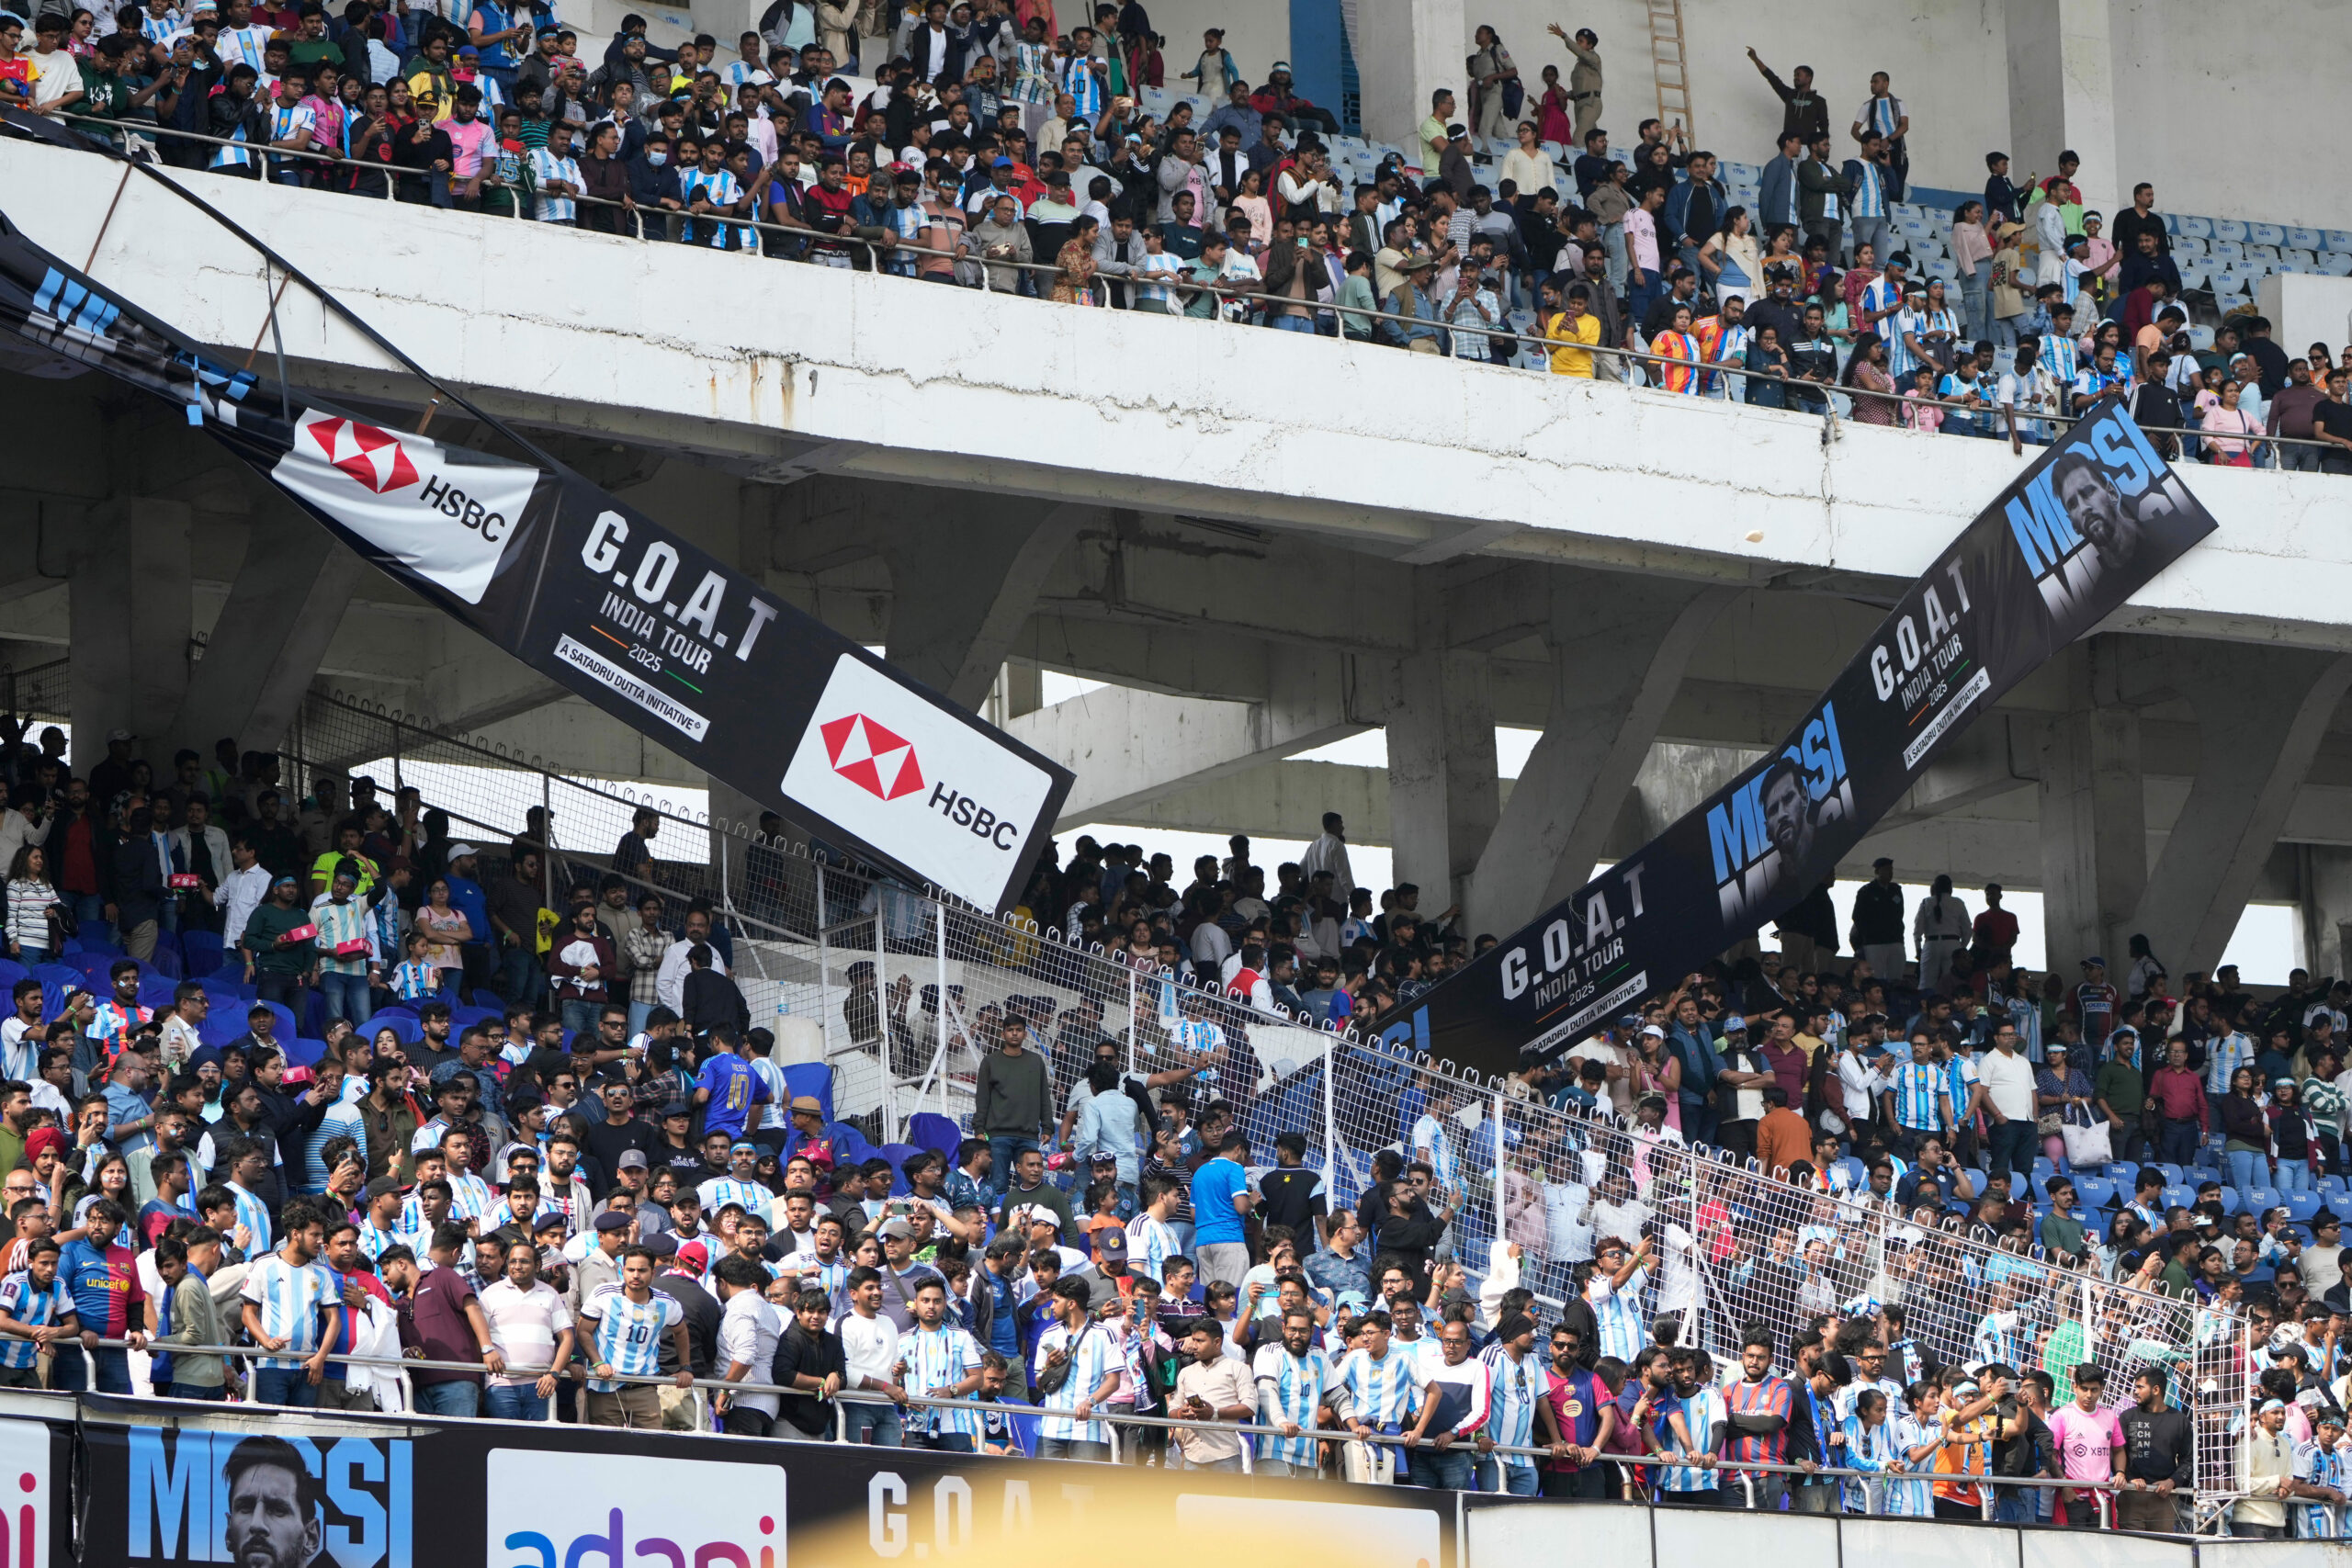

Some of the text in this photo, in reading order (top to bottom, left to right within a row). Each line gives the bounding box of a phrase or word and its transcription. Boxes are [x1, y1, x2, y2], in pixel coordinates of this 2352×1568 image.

[1073, 79, 1086, 94] 10
[420, 474, 506, 544] HSBC
[582, 510, 779, 661] G.O.A.T
[599, 591, 712, 674] INDIA TOUR
[1871, 555, 1970, 702] G.O.A.T
[628, 643, 663, 672] 2025
[1901, 633, 1963, 712] INDIA TOUR
[560, 643, 694, 731] A SATADRU DUTTA INITIATIVE
[1928, 679, 1948, 707] 2025
[1907, 682, 1981, 764] A SATADRU DUTTA INITIATIVE
[928, 781, 1018, 852] HSBC
[1500, 861, 1645, 1000] G.O.A.T
[1534, 937, 1624, 1010] INDIA TOUR
[1568, 982, 1595, 1007] 2025
[1569, 1010, 1596, 1035] DUTTA
[1596, 983, 1637, 1017] INITIATIVE
[727, 1073, 750, 1111] 10
[86, 1277, 119, 1290] unicef
[626, 1324, 649, 1344] 10
[1299, 1383, 1311, 1398] 10
[1516, 1388, 1531, 1404] 10
[2137, 1421, 2150, 1429] EX
[2137, 1430, 2151, 1438] CH
[2137, 1440, 2151, 1449] AN
